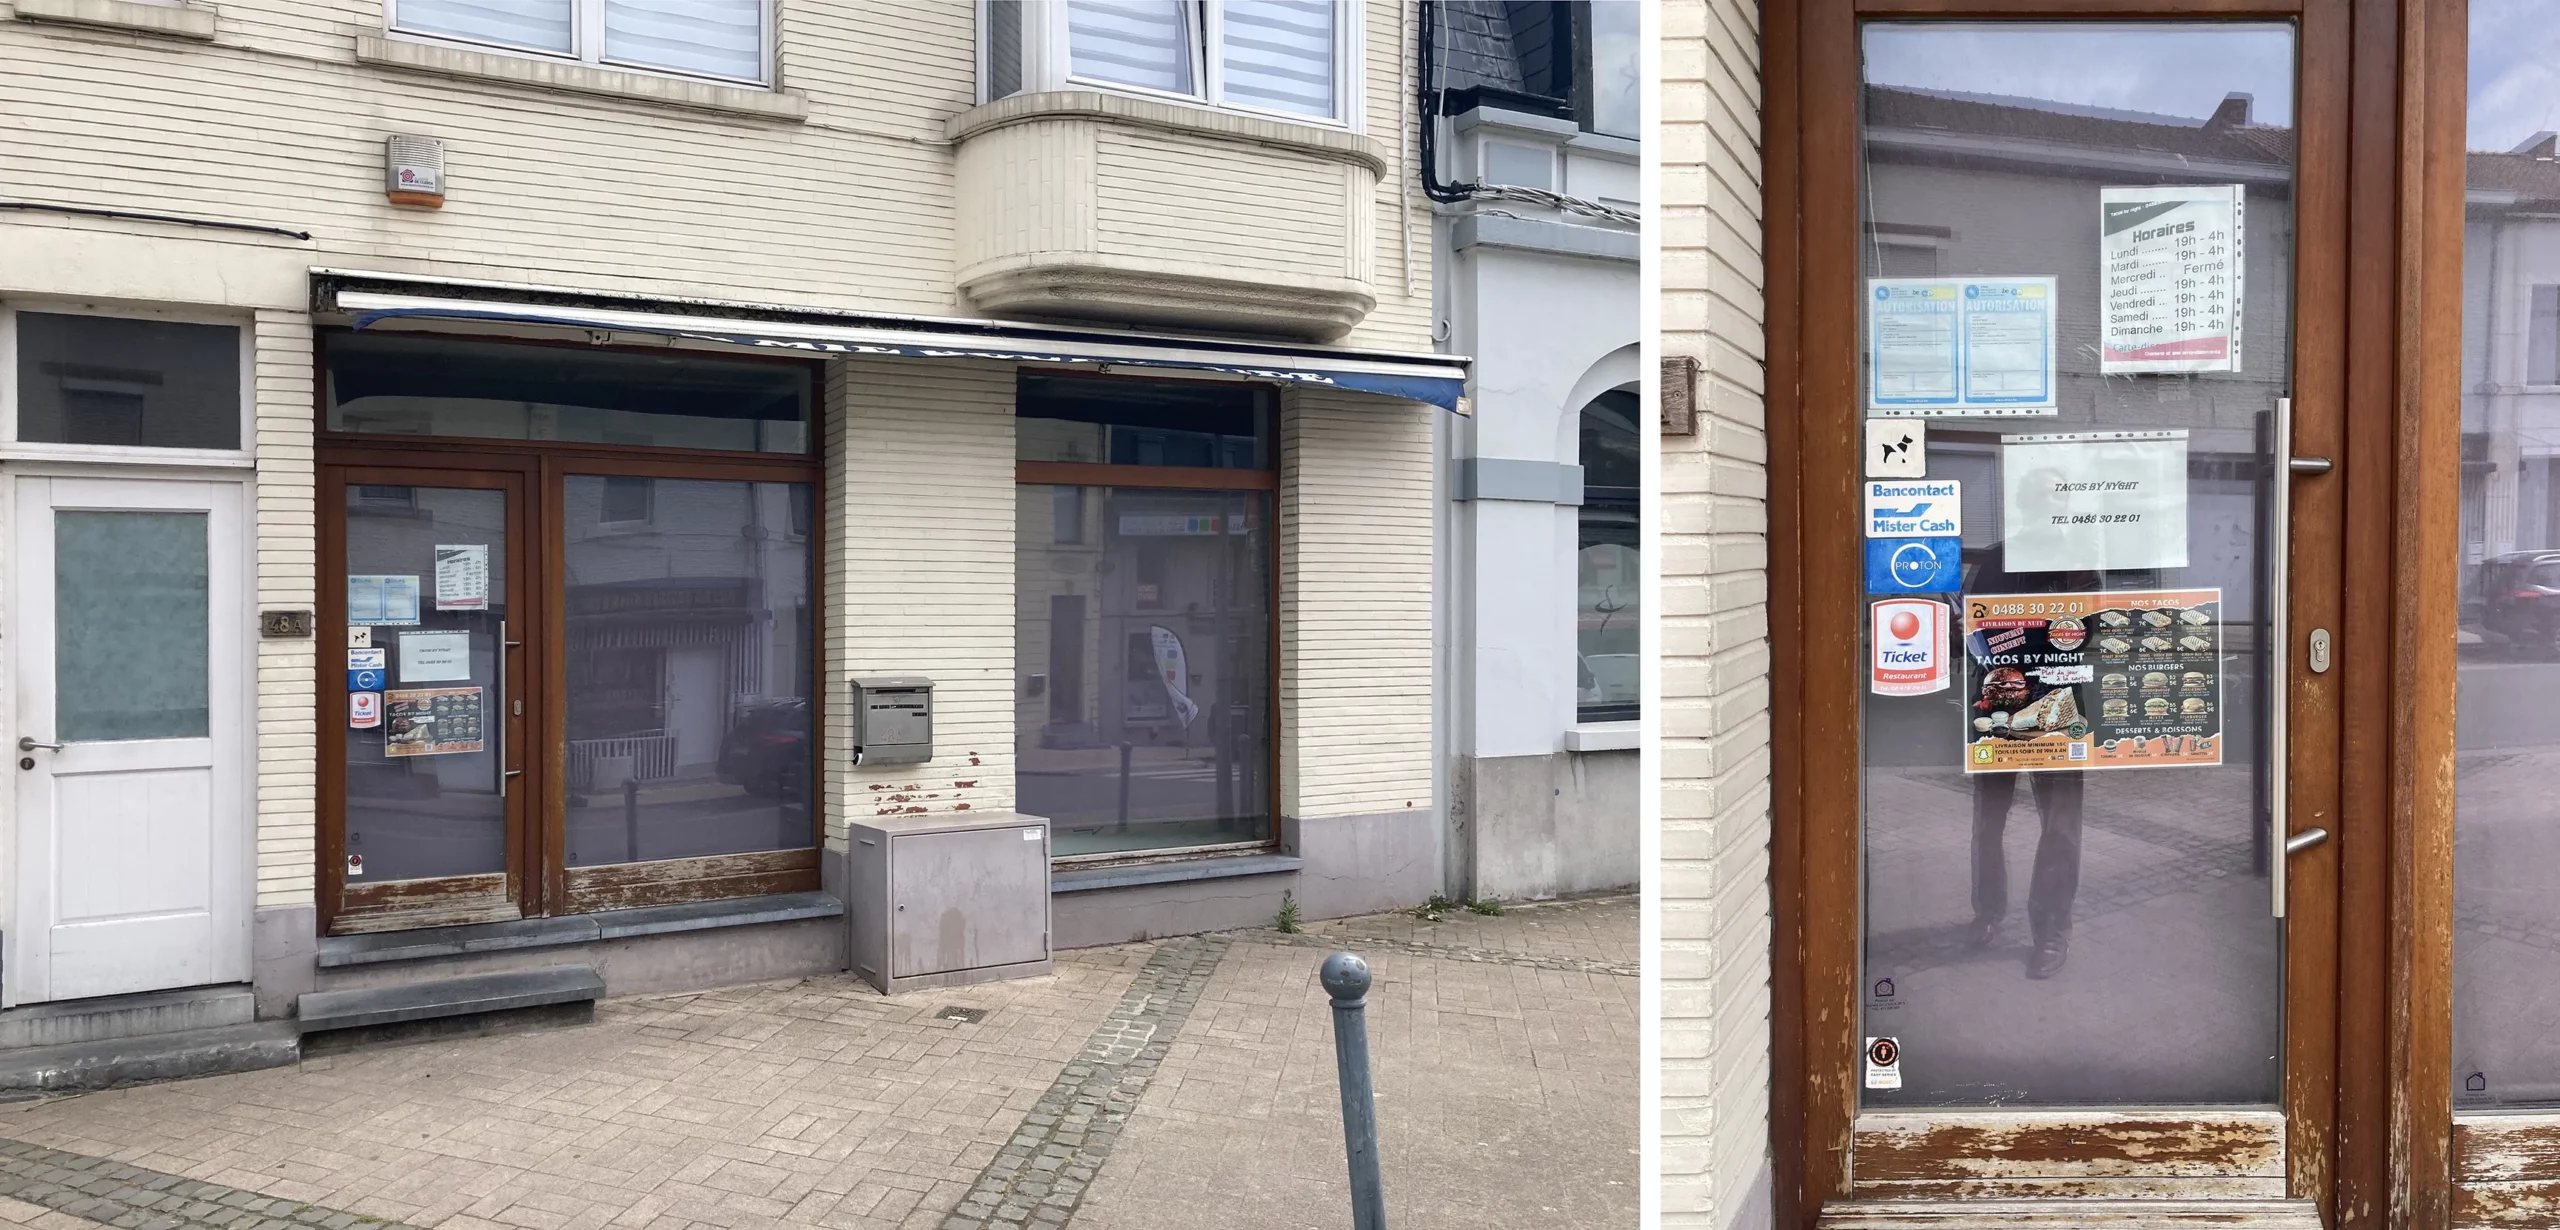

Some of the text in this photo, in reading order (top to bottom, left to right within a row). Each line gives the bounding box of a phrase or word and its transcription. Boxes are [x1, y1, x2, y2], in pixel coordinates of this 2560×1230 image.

[2133, 221, 2194, 243] Horaires
[2111, 230, 2224, 260] Lundi 19h 4h
[2111, 245, 2224, 272] Mardi 19h 4h
[2111, 261, 2224, 286] Mercredi Fermé
[2110, 275, 2224, 298] Jeudi 19h 4h
[1876, 300, 1956, 313] AUTORISATION
[1966, 299, 2045, 312] AUTORISATION
[2110, 290, 2224, 310] Vendredi 19h 4h
[2111, 304, 2224, 324] Samedi 19h 4h
[2111, 319, 2224, 336] Dimanche 19h 4h
[1873, 484, 1954, 497] Bancontact
[2055, 481, 2139, 492] TACOS BY NYGHT
[1873, 520, 1954, 533] Mister Cash
[2051, 516, 2069, 524] TEL
[2072, 514, 2097, 524] 0488
[2099, 514, 2112, 523] 30
[2129, 514, 2140, 522] 01
[1896, 560, 1942, 571] PROTON
[1992, 602, 2084, 615] 0488 30 22 01
[1987, 627, 2024, 646] NOUVEAU
[1990, 636, 2026, 654] CONCEPT
[1883, 651, 1927, 663] Ticket
[1976, 653, 2084, 666] TACOS BY NIGHT
